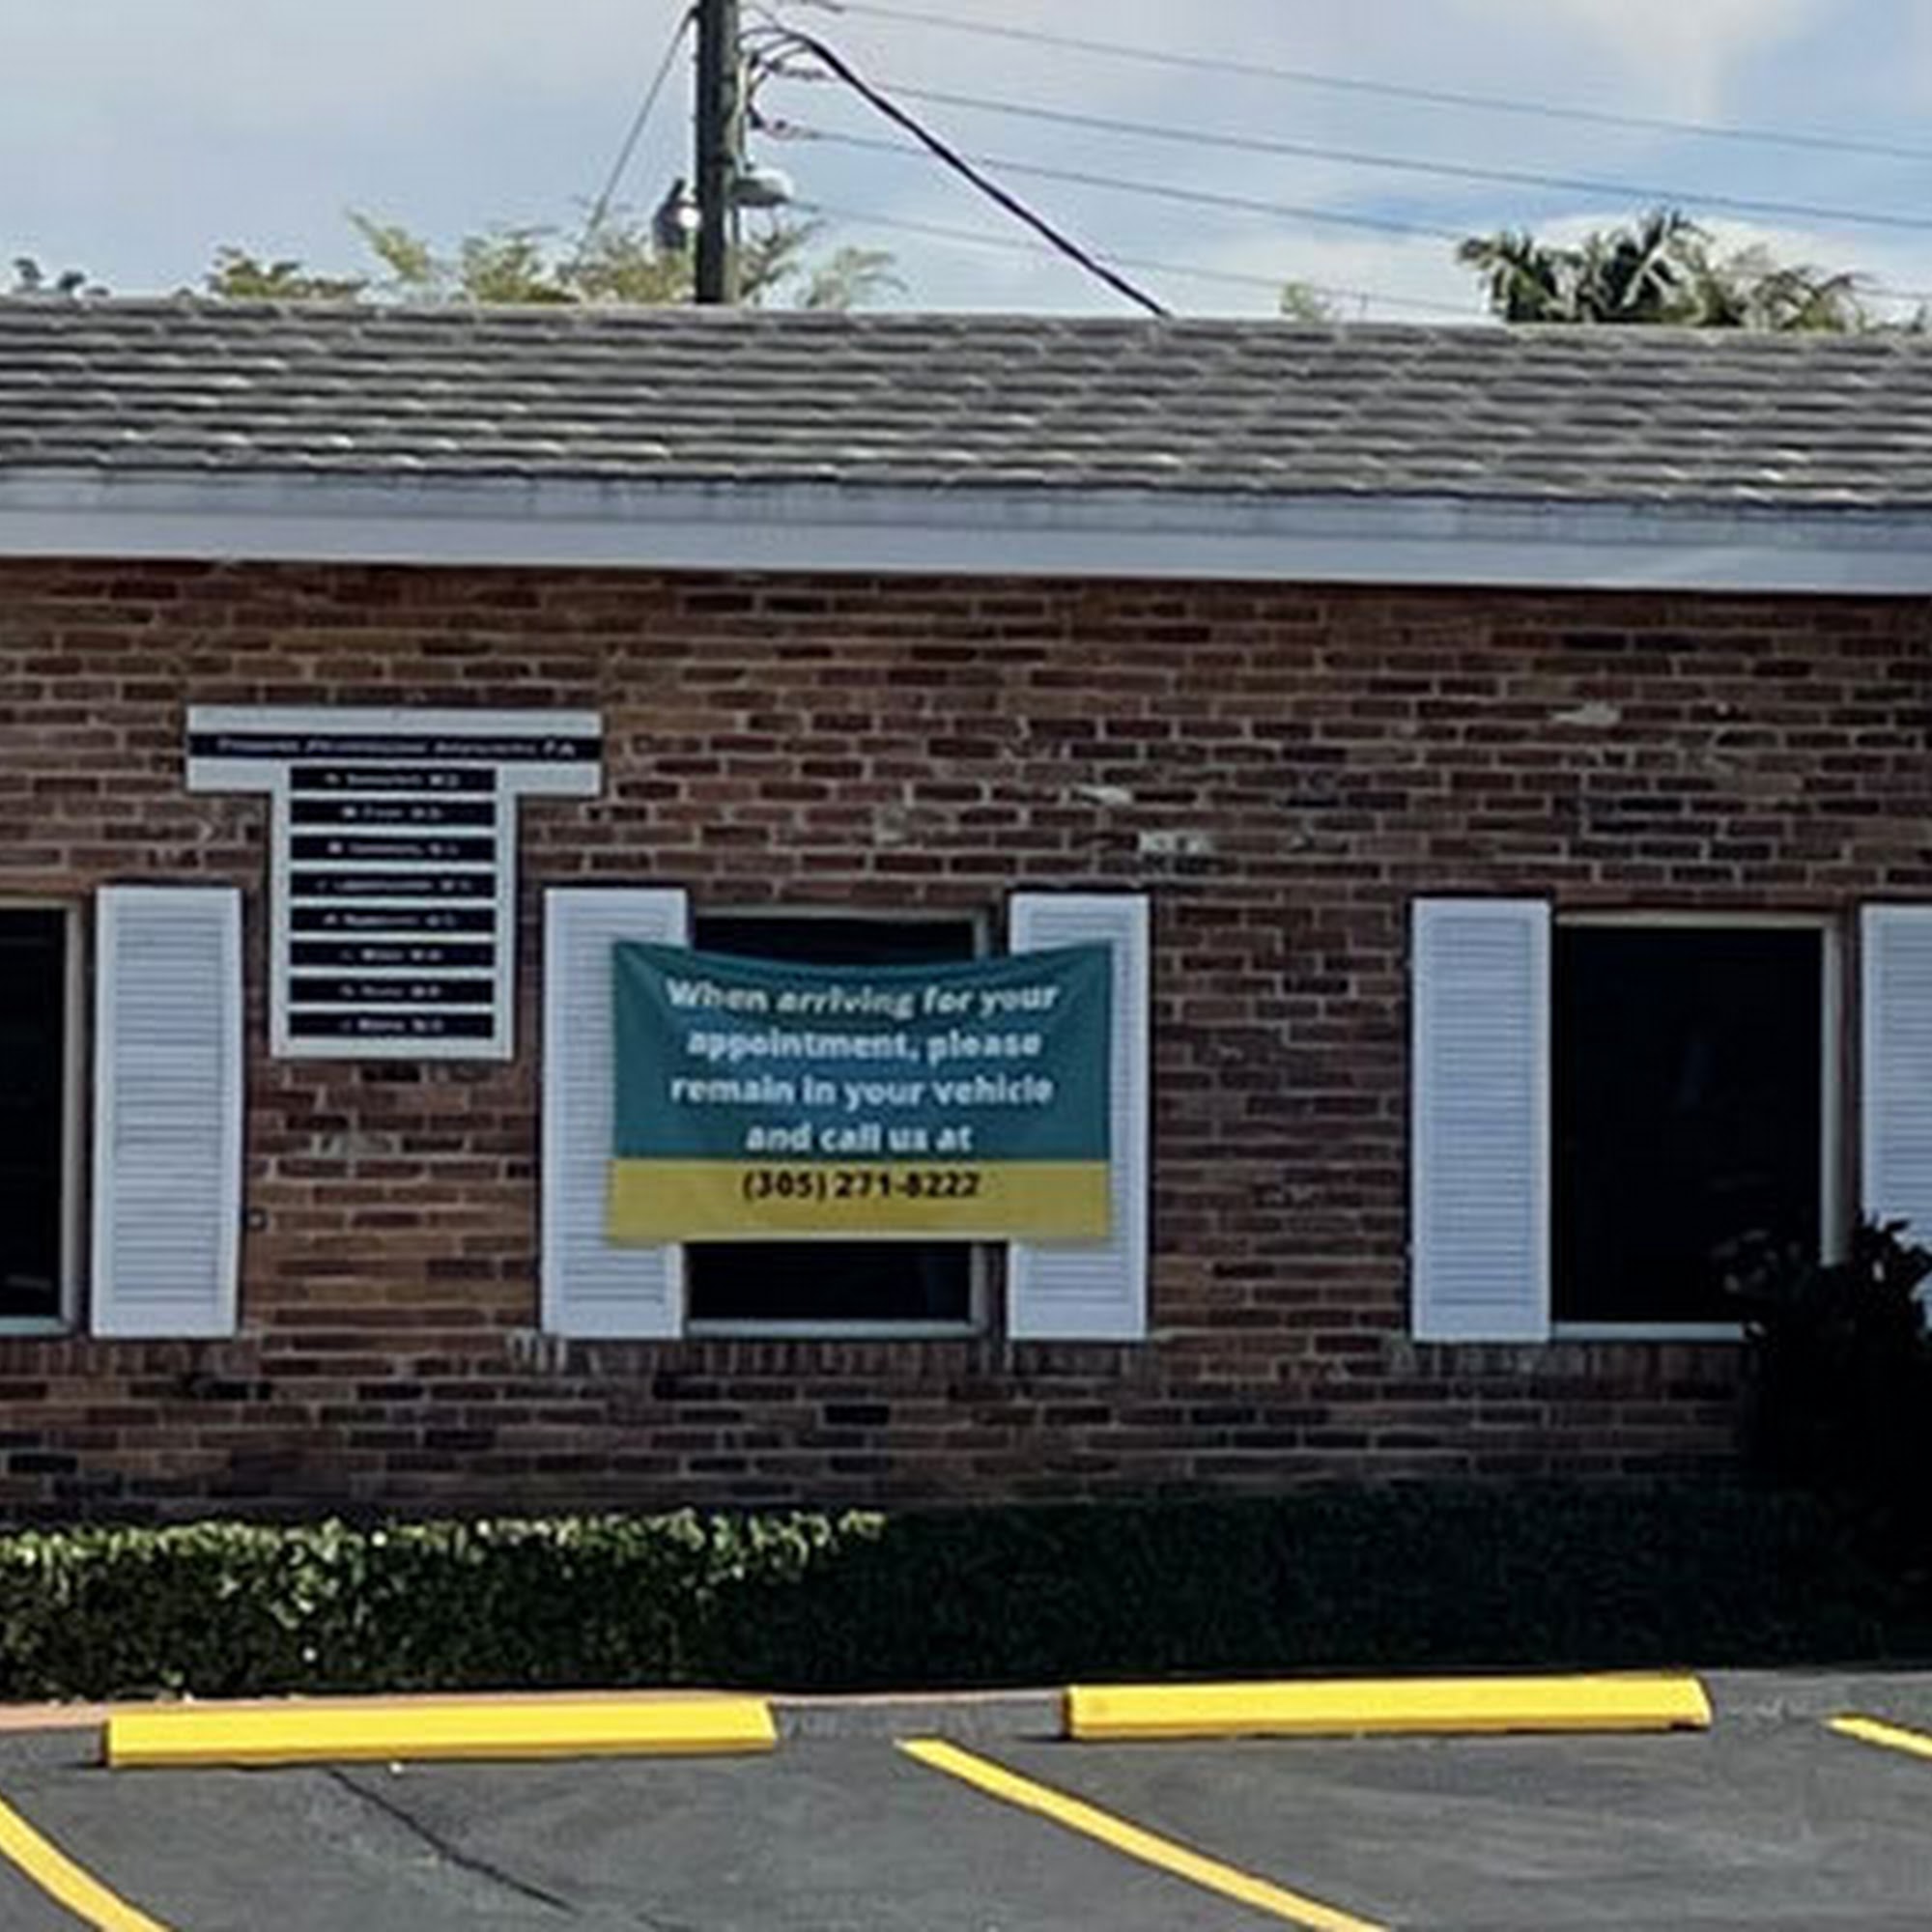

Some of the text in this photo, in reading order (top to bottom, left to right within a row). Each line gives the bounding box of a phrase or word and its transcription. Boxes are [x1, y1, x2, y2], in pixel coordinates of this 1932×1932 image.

[667, 977, 1061, 1021] When arriving for your
[687, 1026, 1042, 1067] appointment, please
[670, 1070, 1054, 1112] remain in your vehicle
[745, 1122, 974, 1152] and call us at
[742, 1169, 981, 1203] (305) 271-8222
